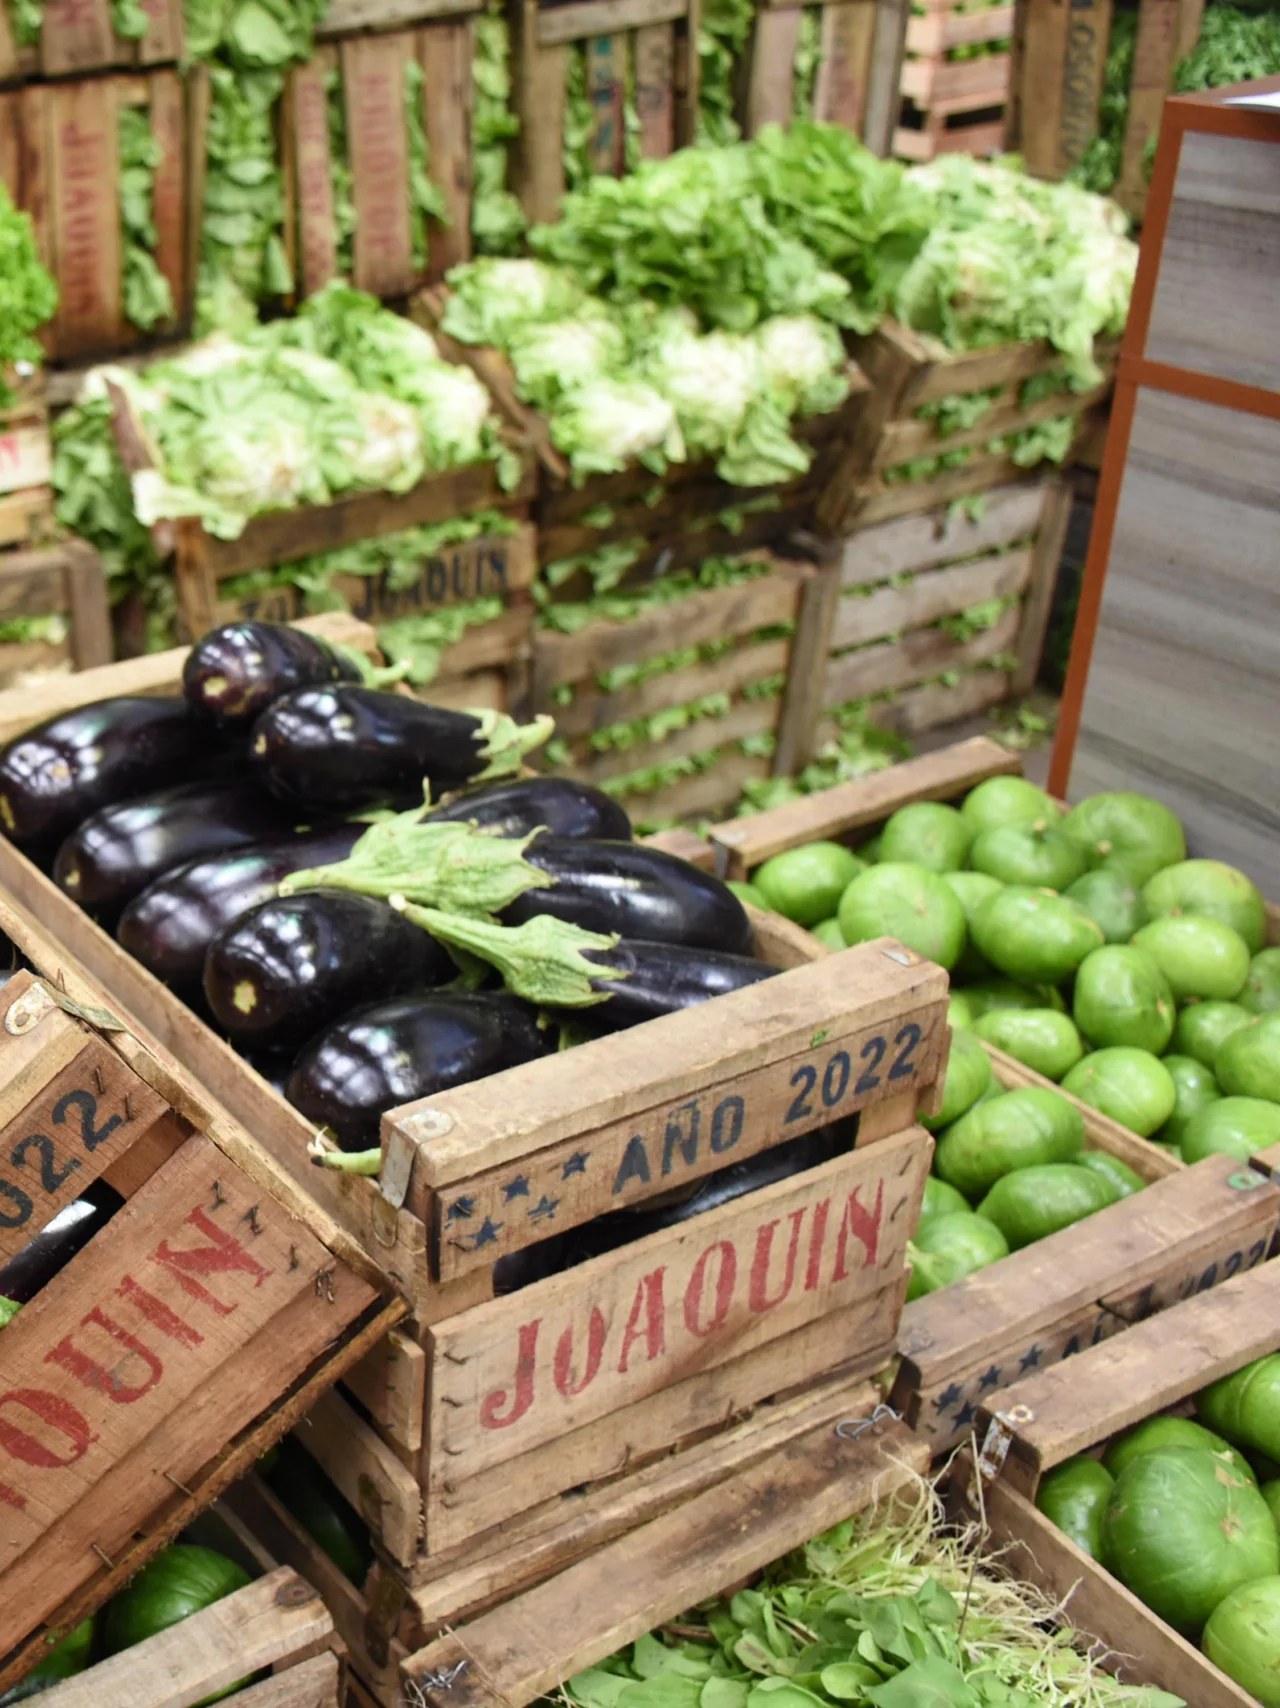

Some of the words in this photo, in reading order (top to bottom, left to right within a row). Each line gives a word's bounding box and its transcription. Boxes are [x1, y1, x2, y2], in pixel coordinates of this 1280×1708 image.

[611, 1096, 745, 1195] AÑO
[784, 1023, 923, 1126] 2022
[479, 1178, 886, 1431] JOAQUIN
